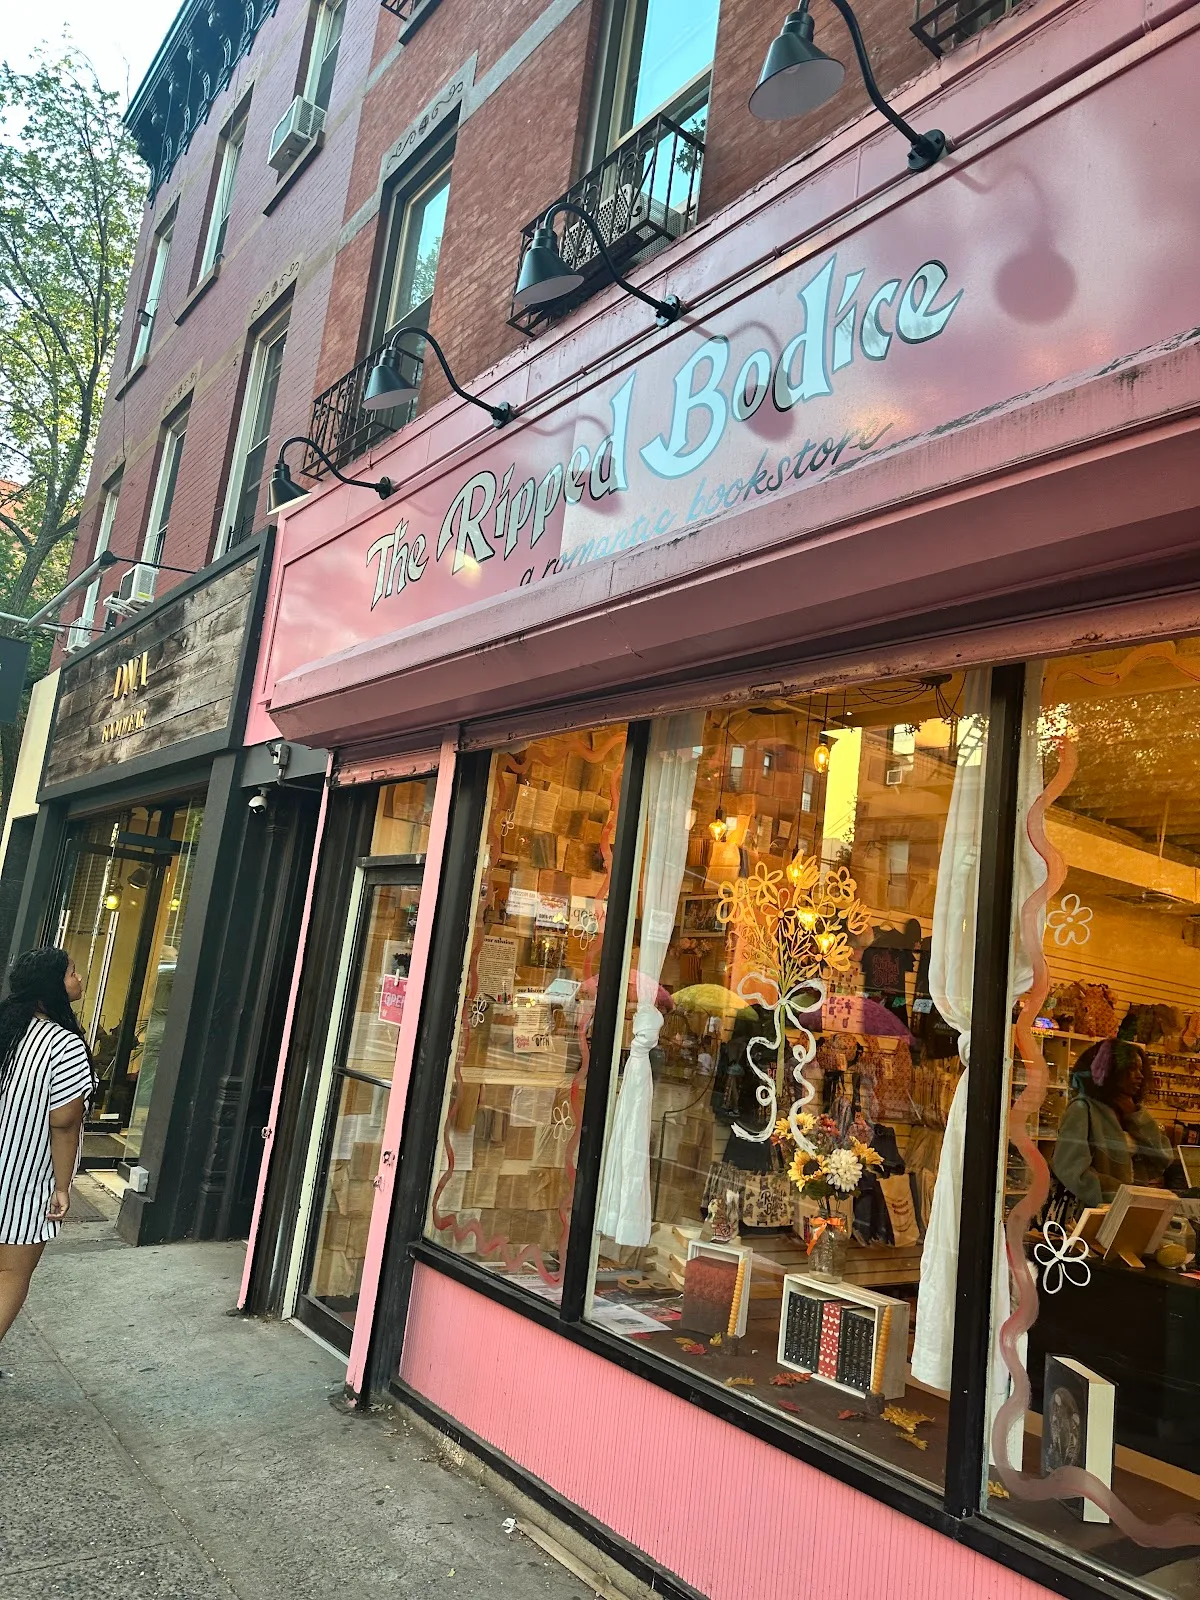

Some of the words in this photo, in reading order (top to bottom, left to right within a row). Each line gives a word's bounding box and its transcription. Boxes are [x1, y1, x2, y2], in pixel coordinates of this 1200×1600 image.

[366, 517, 430, 612] The
[436, 368, 636, 576] Ripped
[640, 252, 965, 480] Bodice
[520, 564, 536, 587] a
[543, 507, 678, 574] romantic
[684, 422, 894, 523] bookstore
